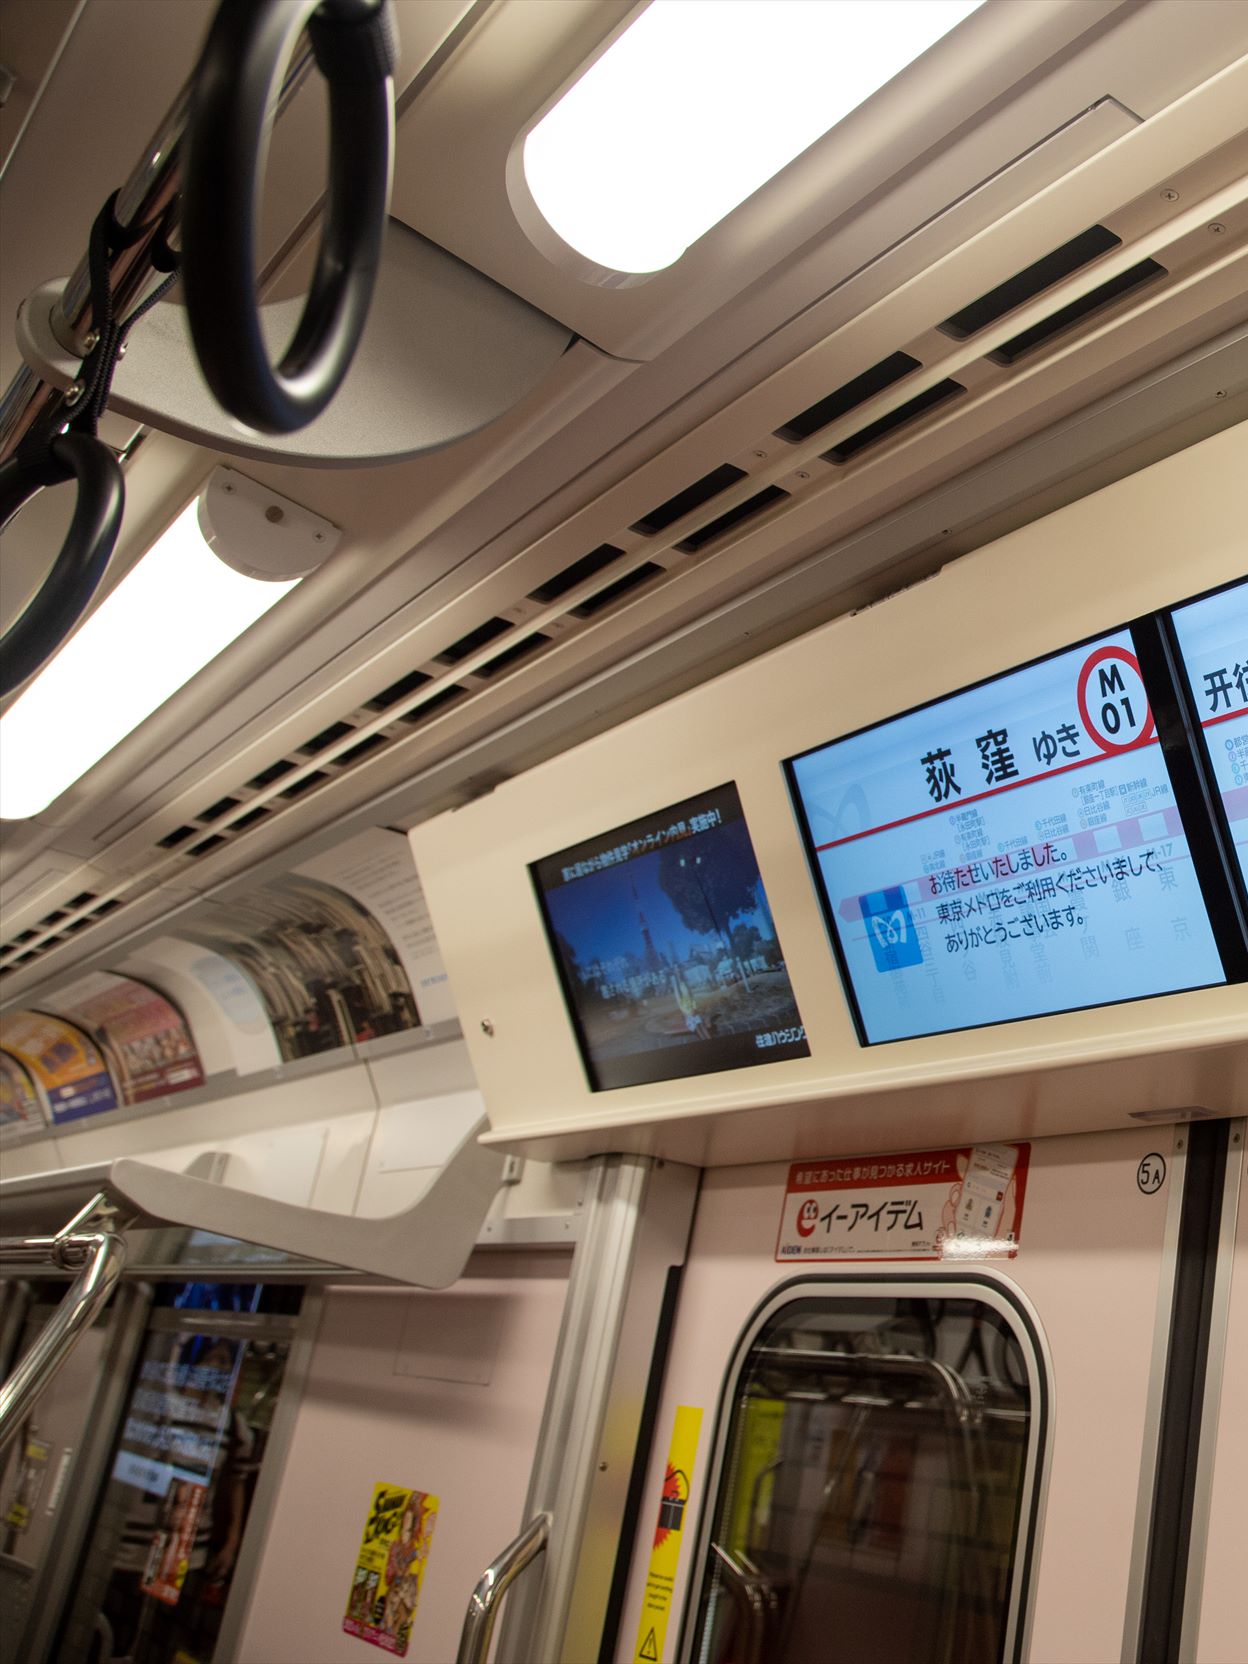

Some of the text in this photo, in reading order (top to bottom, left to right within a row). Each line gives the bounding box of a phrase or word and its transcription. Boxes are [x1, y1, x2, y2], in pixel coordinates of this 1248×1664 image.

[1097, 664, 1127, 698] M
[1100, 697, 1137, 735] 01
[920, 722, 1082, 803] 荻窪 ゆき
[929, 842, 1067, 895] お待たせいたしました。
[936, 851, 1163, 925] 東京メトロをご利用くださいまして、
[944, 905, 1083, 954] ありがとうございます。
[1141, 1163, 1160, 1185] 5A
[820, 1200, 923, 1233] イーアイデム
